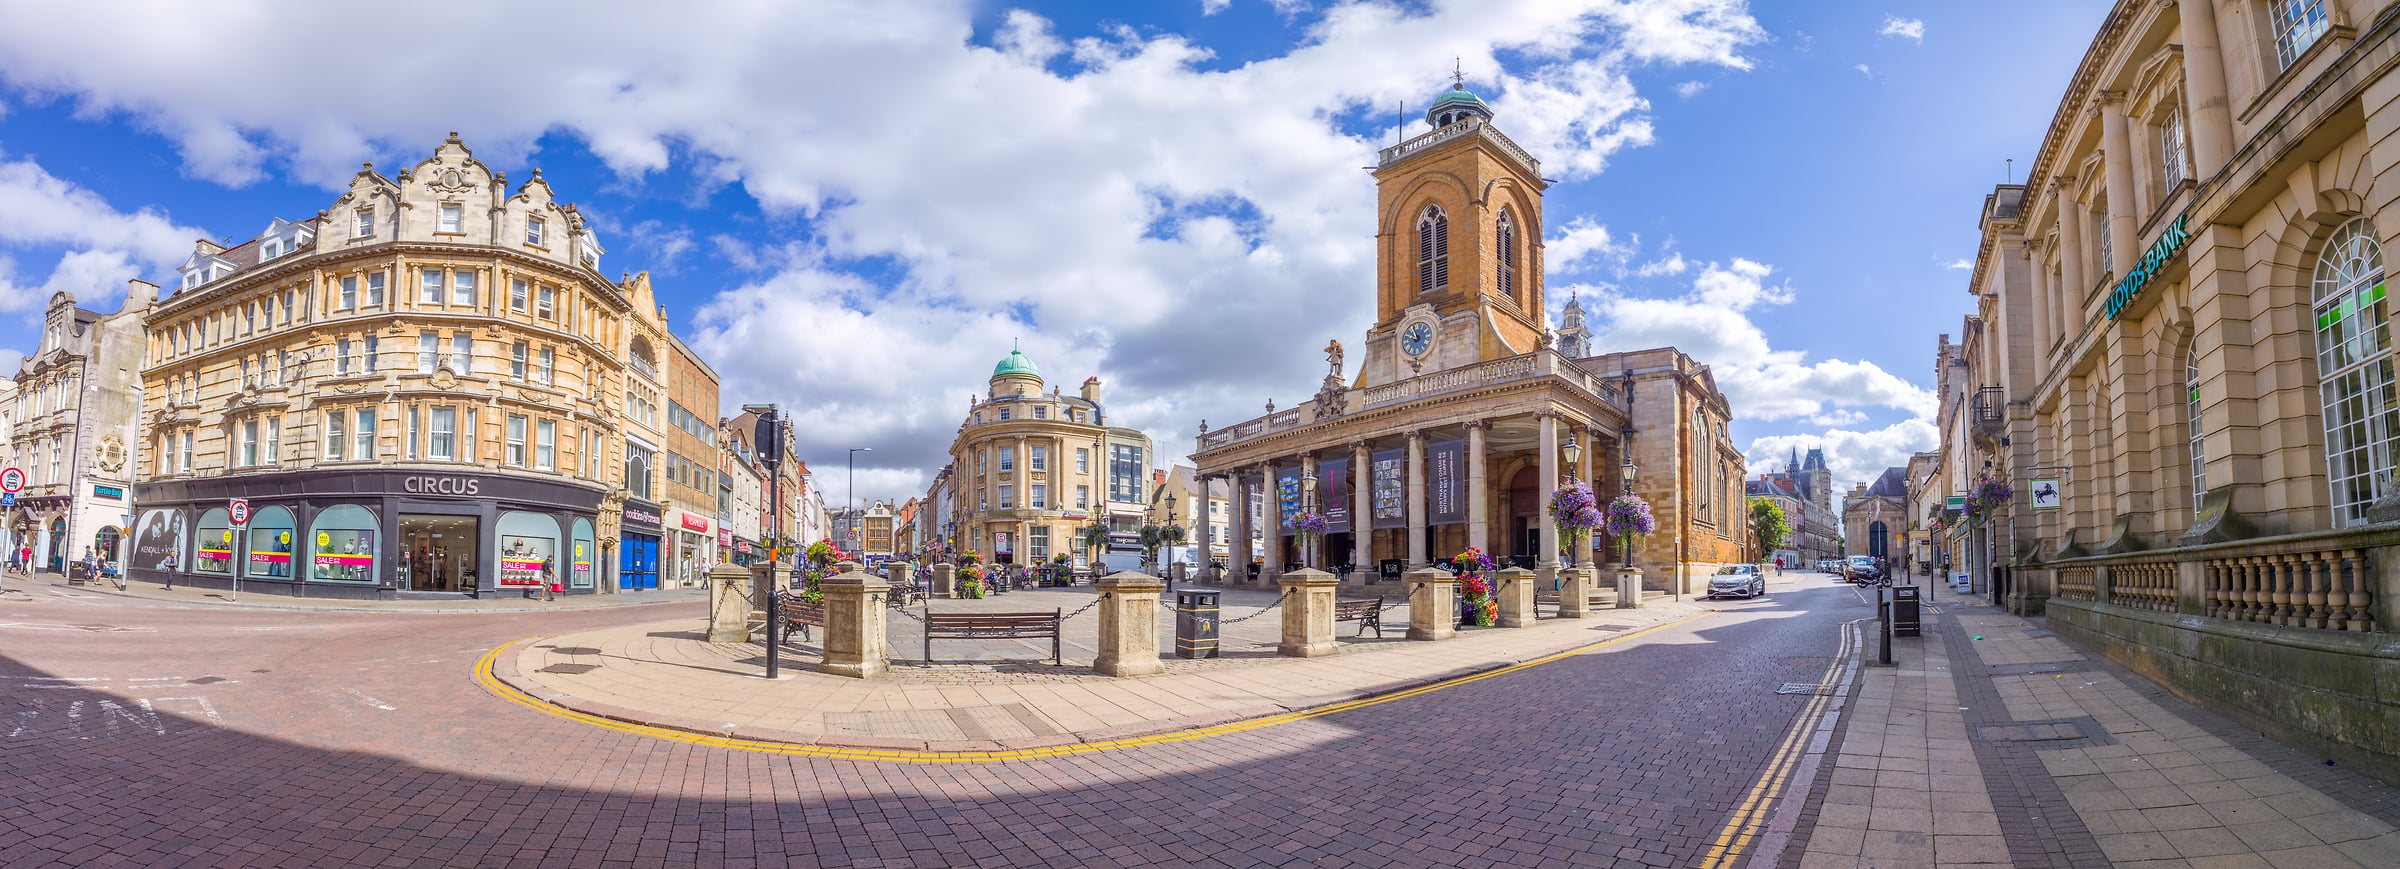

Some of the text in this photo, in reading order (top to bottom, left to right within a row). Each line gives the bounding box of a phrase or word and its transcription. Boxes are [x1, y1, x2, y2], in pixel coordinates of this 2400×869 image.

[2105, 214, 2188, 320] LLOYDS BANK
[404, 476, 479, 495] CIRCUS
[95, 485, 122, 499] Turtle Bay
[251, 554, 264, 562] SALE
[316, 556, 333, 564] SALE
[502, 561, 519, 569] SALE
